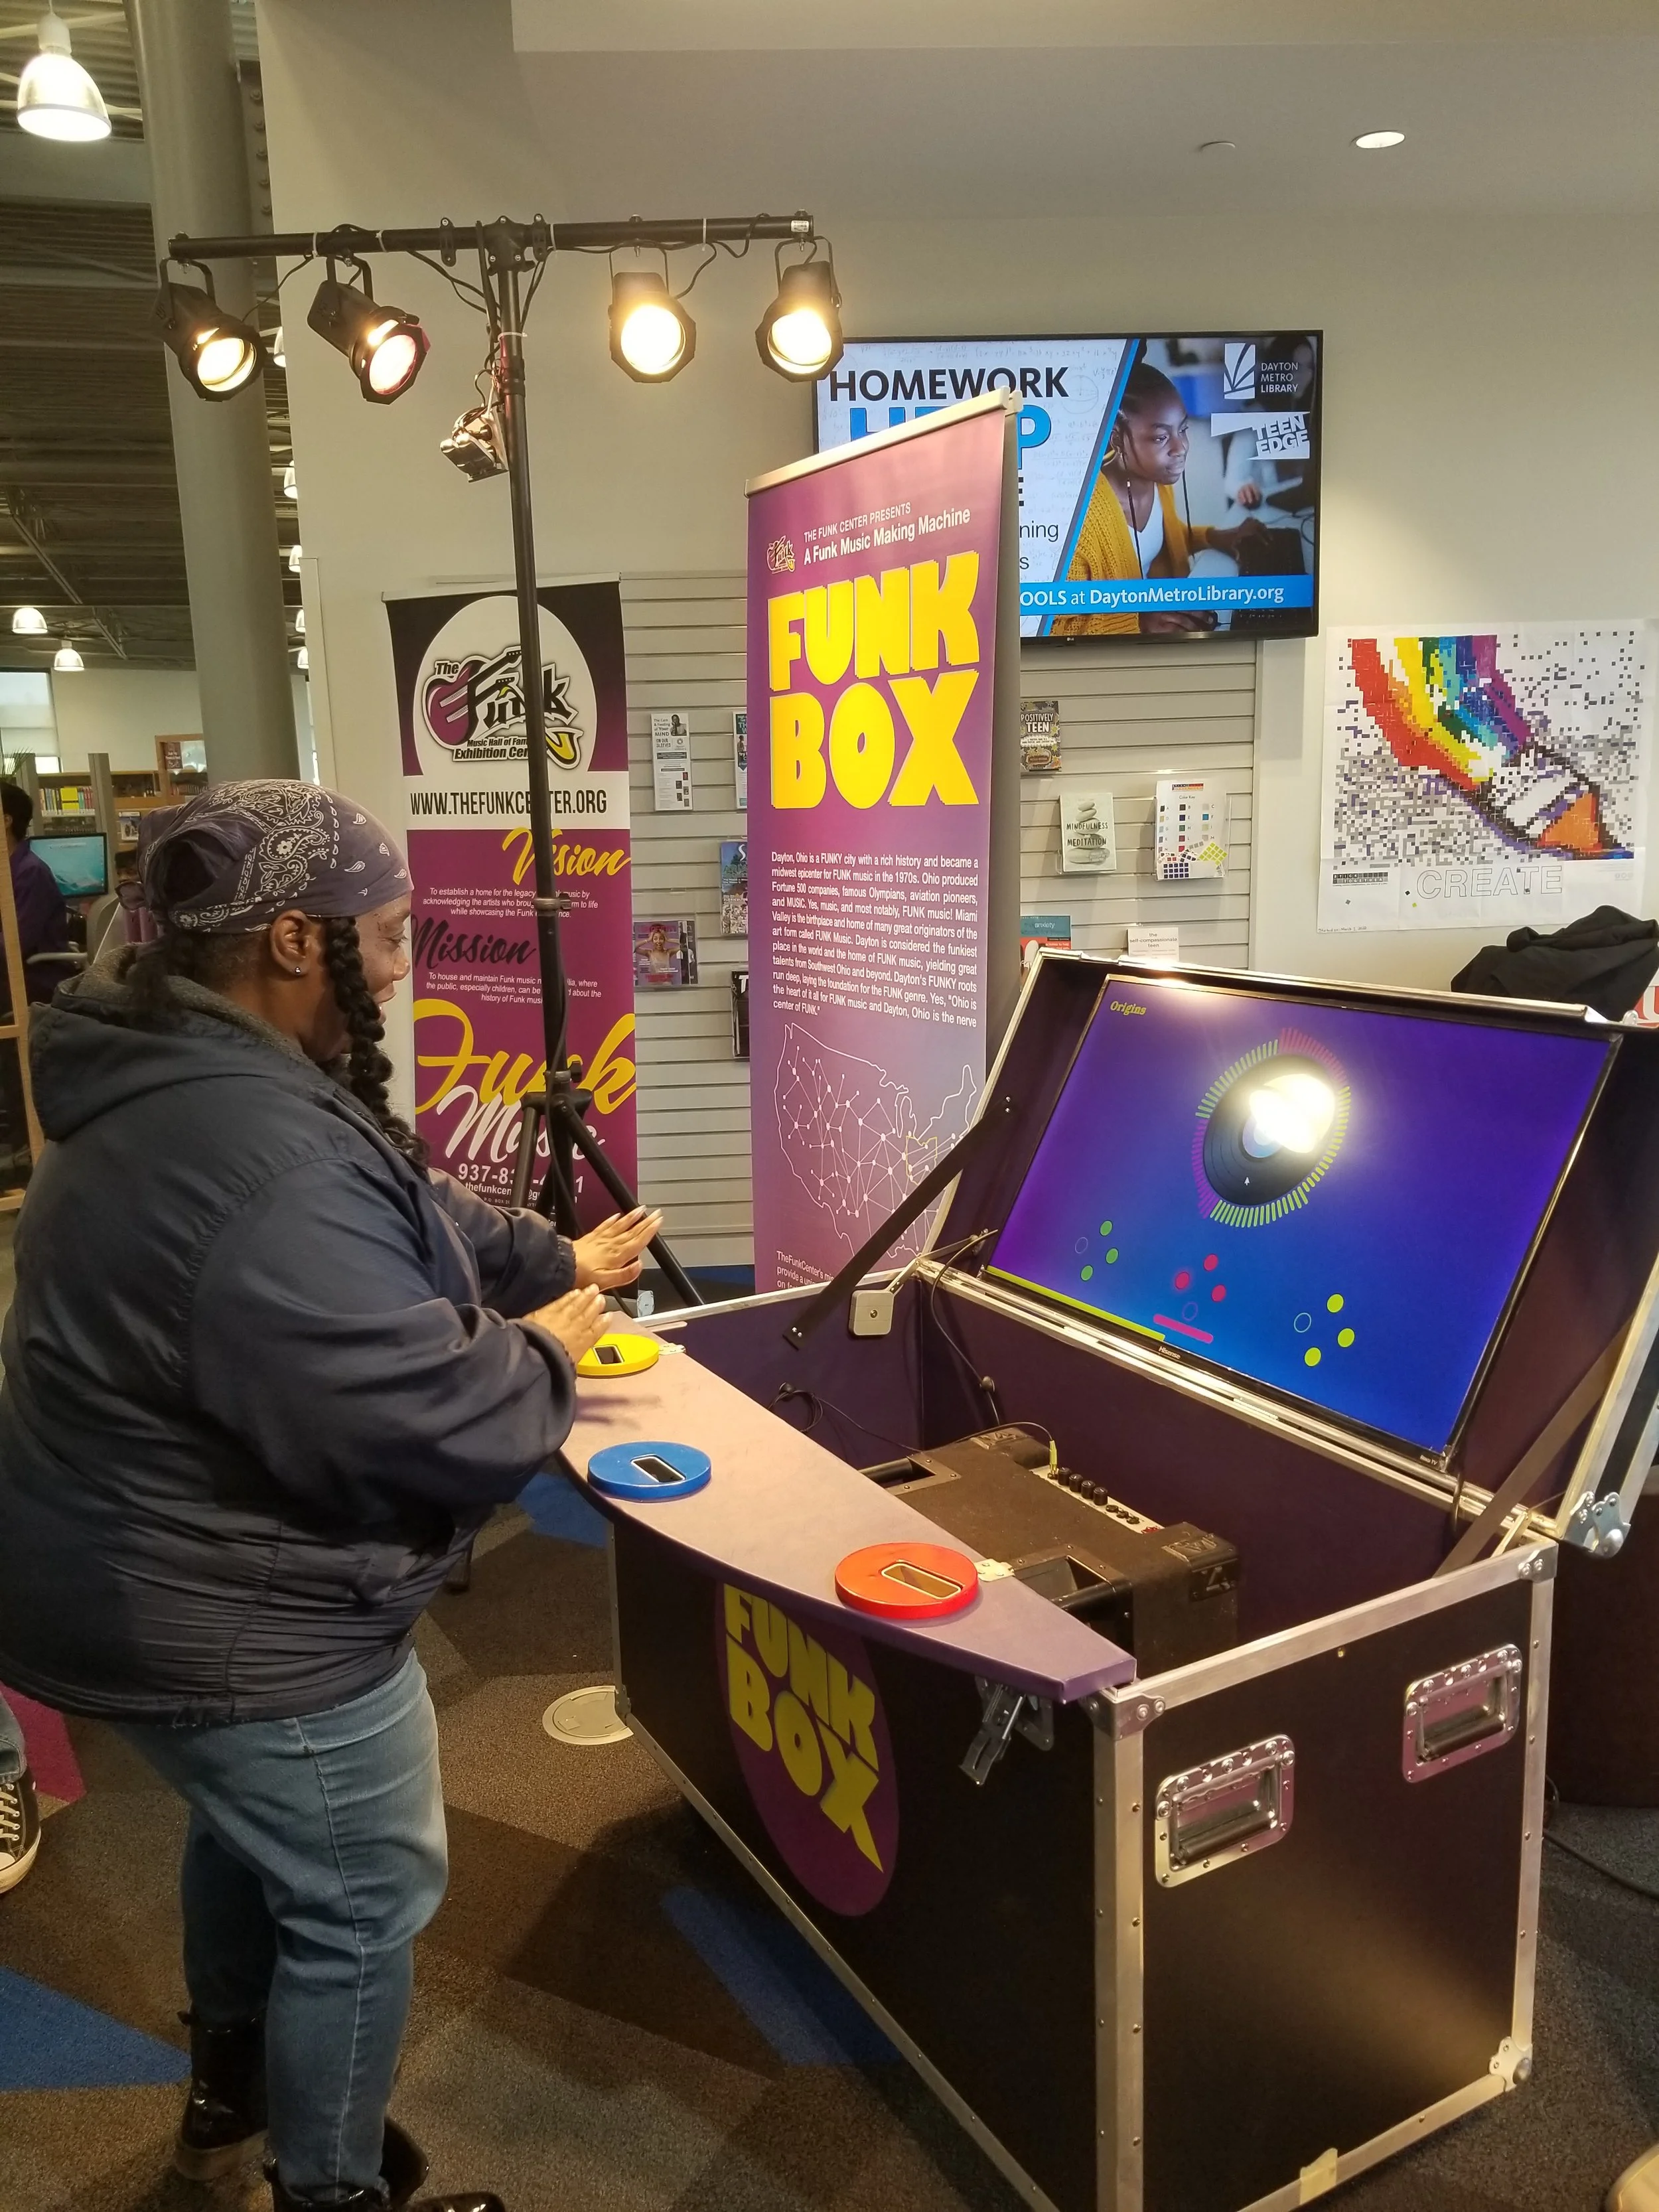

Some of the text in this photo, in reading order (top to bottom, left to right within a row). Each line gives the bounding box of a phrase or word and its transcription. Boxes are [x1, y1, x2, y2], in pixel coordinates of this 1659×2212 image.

[1262, 362, 1298, 371] DAYTON
[829, 366, 1070, 402] HOMEWORK
[1261, 384, 1299, 393] LIBRARY
[1252, 413, 1306, 440] TEEN
[1256, 430, 1310, 456] EDGE
[804, 502, 911, 543] THE FUNK CENTER PRESENTS
[1019, 520, 1059, 542] ning
[804, 507, 971, 566] A Funk Music Making Machine
[1019, 585, 1284, 608] OOLS at DaytonMetroLibrary.org
[768, 550, 980, 692] FUNK
[436, 662, 460, 676] The
[1021, 713, 1054, 721] POSITIVELY
[1025, 721, 1050, 733] TEEN
[769, 668, 980, 810] BOX
[455, 747, 507, 760] Exhibition
[1067, 838, 1107, 847] MEDITATION
[771, 852, 794, 866] Dayton,
[795, 853, 808, 863] Ohio
[808, 853, 814, 864] is
[820, 853, 842, 865] FUNKY
[843, 853, 856, 867] city
[857, 853, 872, 865] with
[880, 854, 893, 866] rich
[895, 854, 921, 869] history
[923, 855, 938, 867] and
[940, 855, 972, 869] became
[973, 859, 978, 869] a
[771, 867, 978, 889] midwest epicenter for FUNK music in the 1970s. Ohio produced
[1416, 865, 1563, 899] CREATE
[423, 897, 470, 907] acknowledging
[514, 889, 536, 899] legacy
[582, 890, 590, 899] by
[772, 881, 977, 907] Fortune 500 companies, famous Olympians, aviation pioneers,
[469, 908, 504, 918] showcasing
[772, 895, 977, 922] and MUSIC. Yes, music, and most notably, FUNK music! Miami
[771, 910, 977, 940] Valley is the birthplace and home of many great originators of the
[412, 916, 536, 970] Mission
[437, 982, 459, 991] public,
[460, 984, 491, 993] especially
[492, 984, 517, 994] children,
[481, 994, 501, 1003] history
[1110, 1000, 1147, 1015] Origins
[776, 1250, 824, 1279] TheFunkCenter's
[776, 1266, 799, 1281] provide
[777, 1280, 786, 1289] on
[1158, 1345, 1181, 1360] Hisense
[723, 1583, 879, 1773] FUNK
[725, 1633, 884, 1873] BOX
